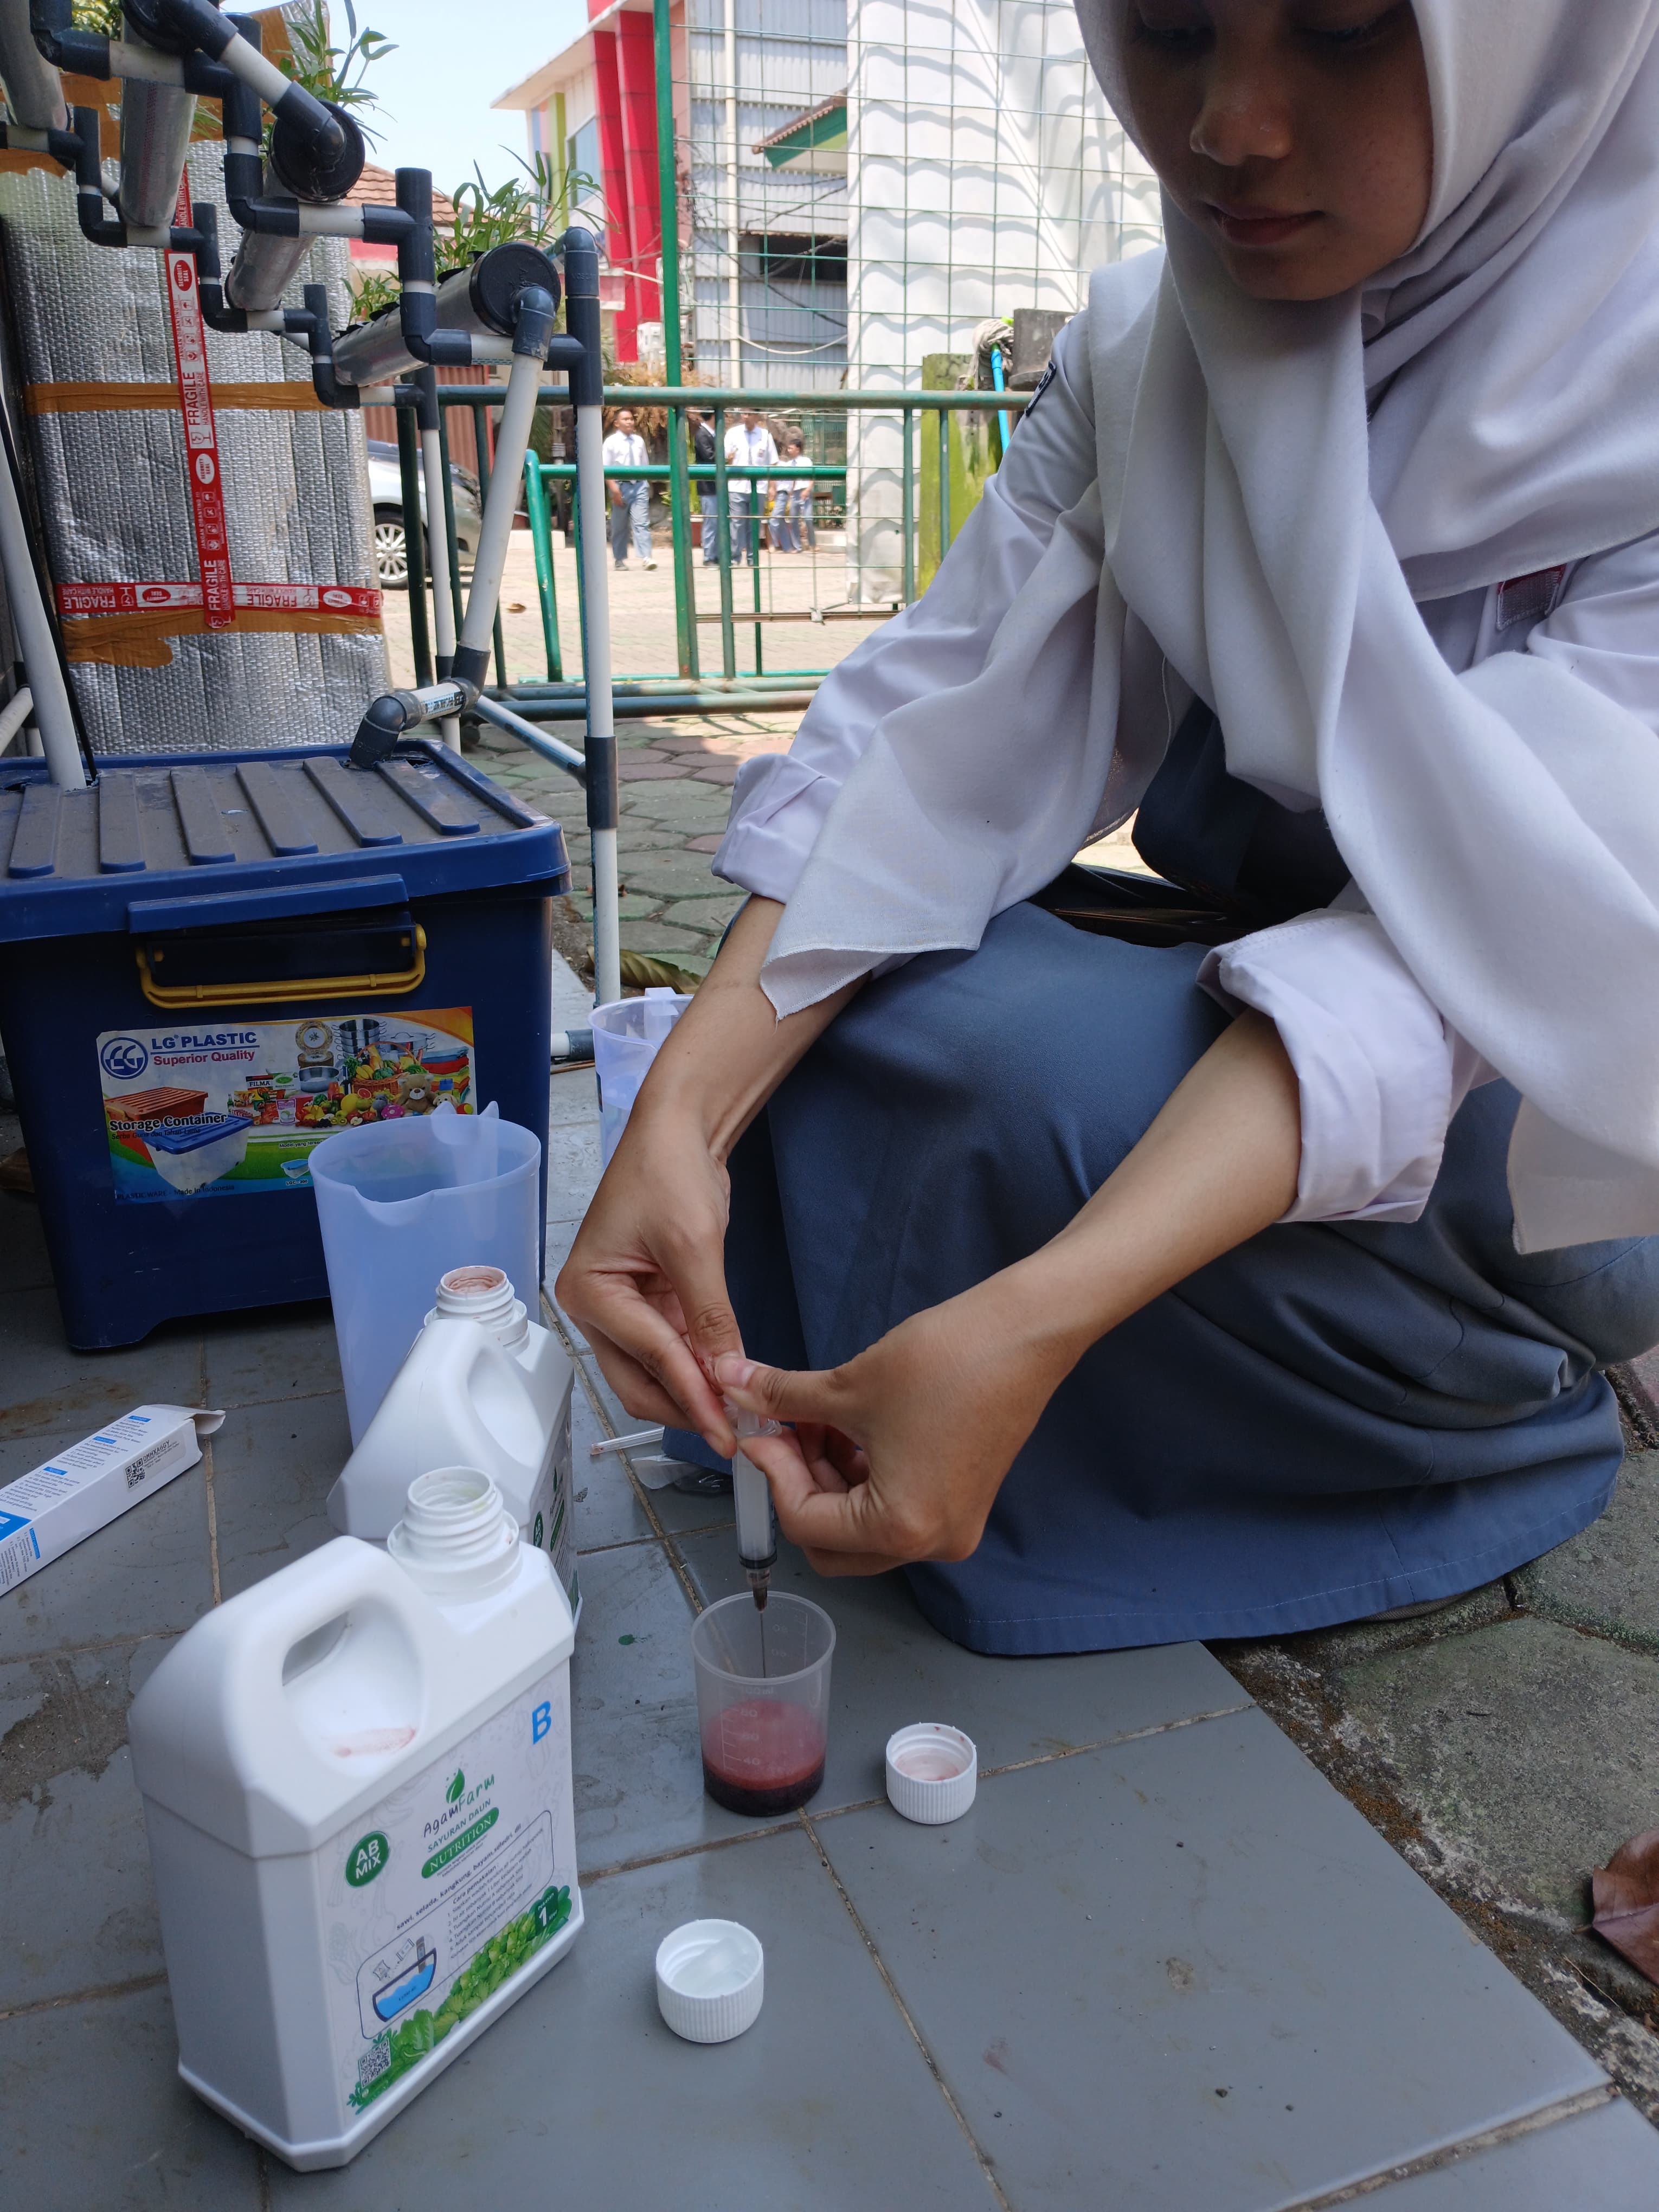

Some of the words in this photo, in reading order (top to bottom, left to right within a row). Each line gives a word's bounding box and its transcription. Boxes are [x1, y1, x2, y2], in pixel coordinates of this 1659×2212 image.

[197, 372, 205, 387] CARE
[183, 372, 200, 425] FRAGILE
[198, 388, 207, 402] WITH
[200, 402, 209, 425] HANDLE
[217, 560, 226, 575] CARE
[204, 560, 221, 610] FRAGILE
[65, 596, 116, 608] FRAGILE
[247, 594, 297, 607] FRAGILE
[181, 1032, 256, 1047] PLASTIC
[153, 1053, 208, 1066] Superior
[211, 1050, 255, 1061] Quality
[110, 1120, 160, 1132] Storage
[164, 1114, 228, 1127] Container
[203, 1184, 235, 1192] Indonesia
[531, 1701, 552, 1744] B
[428, 1818, 466, 1853] SAYURAN
[469, 1798, 491, 1822] DAUN
[356, 1840, 379, 1866] AB
[429, 1816, 492, 1872] NUTRITION
[356, 1852, 381, 1879] MIX
[453, 1889, 465, 1905] Cara
[467, 1864, 496, 1894] pemakaian
[539, 1906, 547, 1926] 1
